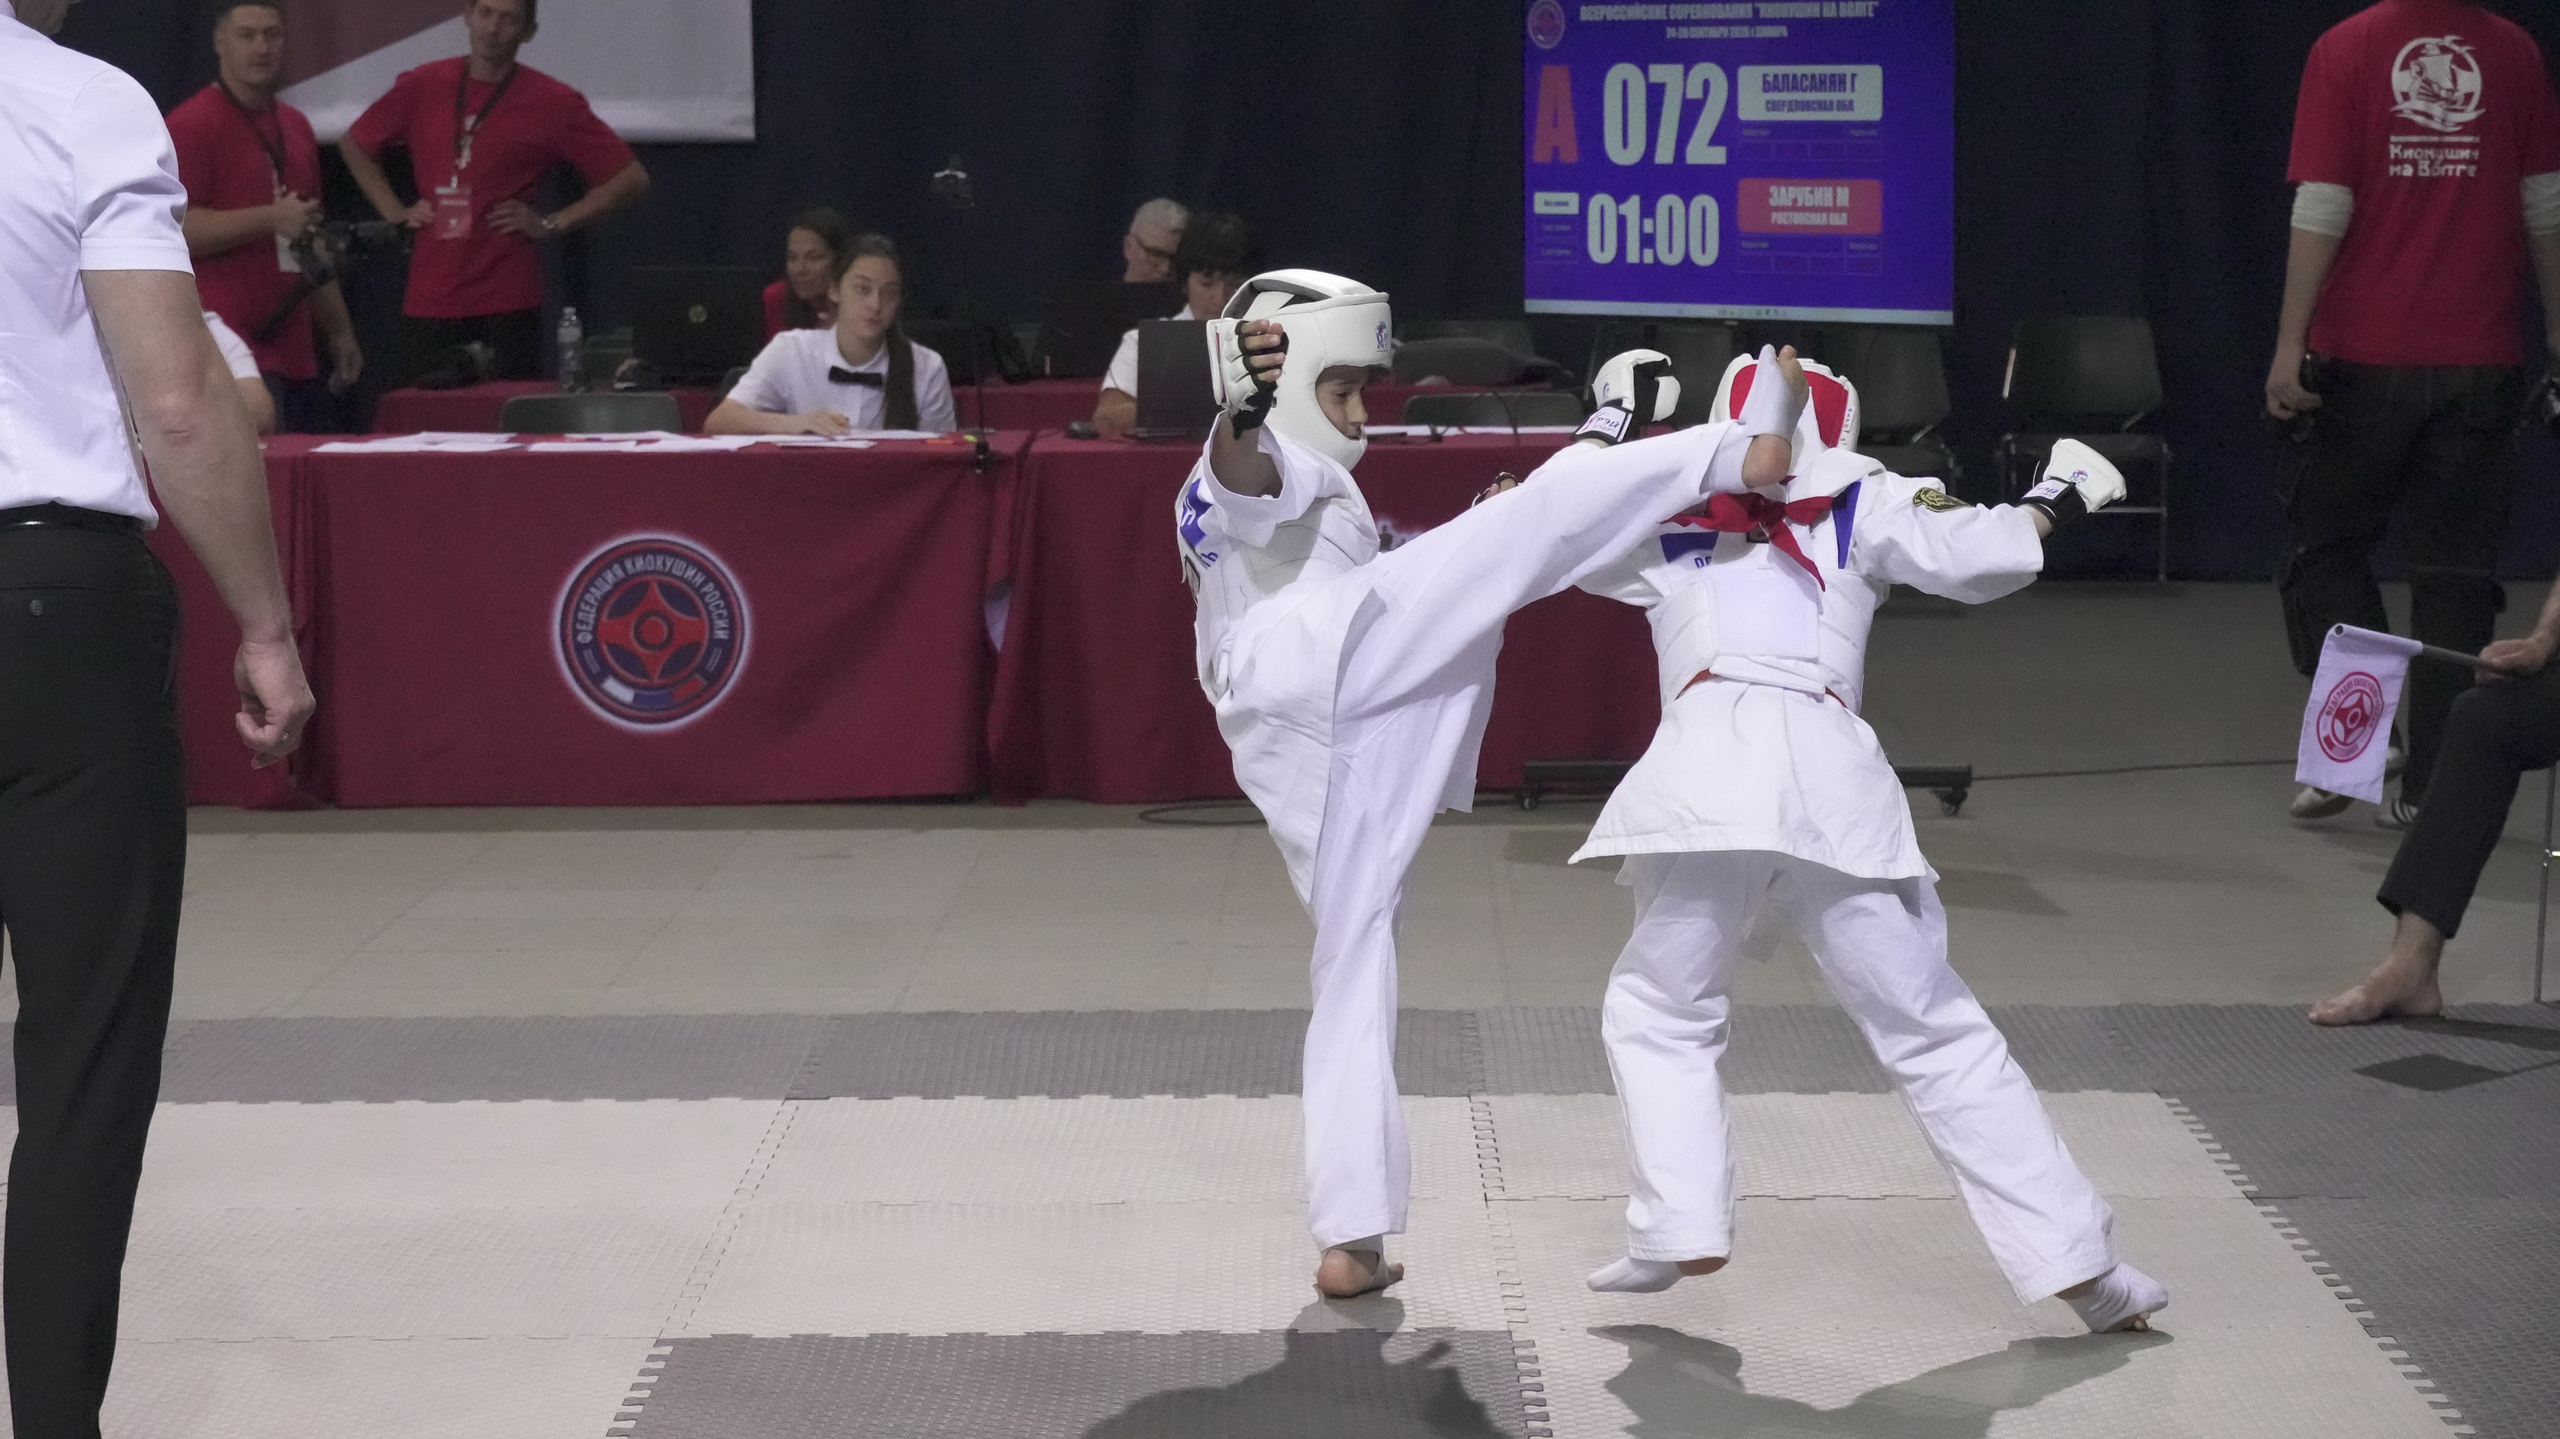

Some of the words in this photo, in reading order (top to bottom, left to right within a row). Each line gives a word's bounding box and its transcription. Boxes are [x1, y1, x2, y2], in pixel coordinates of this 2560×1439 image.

[1762, 72, 1847, 94] БАЛАСАНЯН
[1850, 72, 1858, 93] Г
[1603, 61, 1729, 166] 072
[2389, 164, 2414, 177] на
[1769, 185, 1834, 208] ЗАРУБИН
[1587, 193, 1720, 267] 01:00
[576, 563, 626, 645] ФЕДЕРАЦИЯ
[624, 554, 706, 588] КИОКУШИН
[699, 582, 730, 640] РОССИИ
